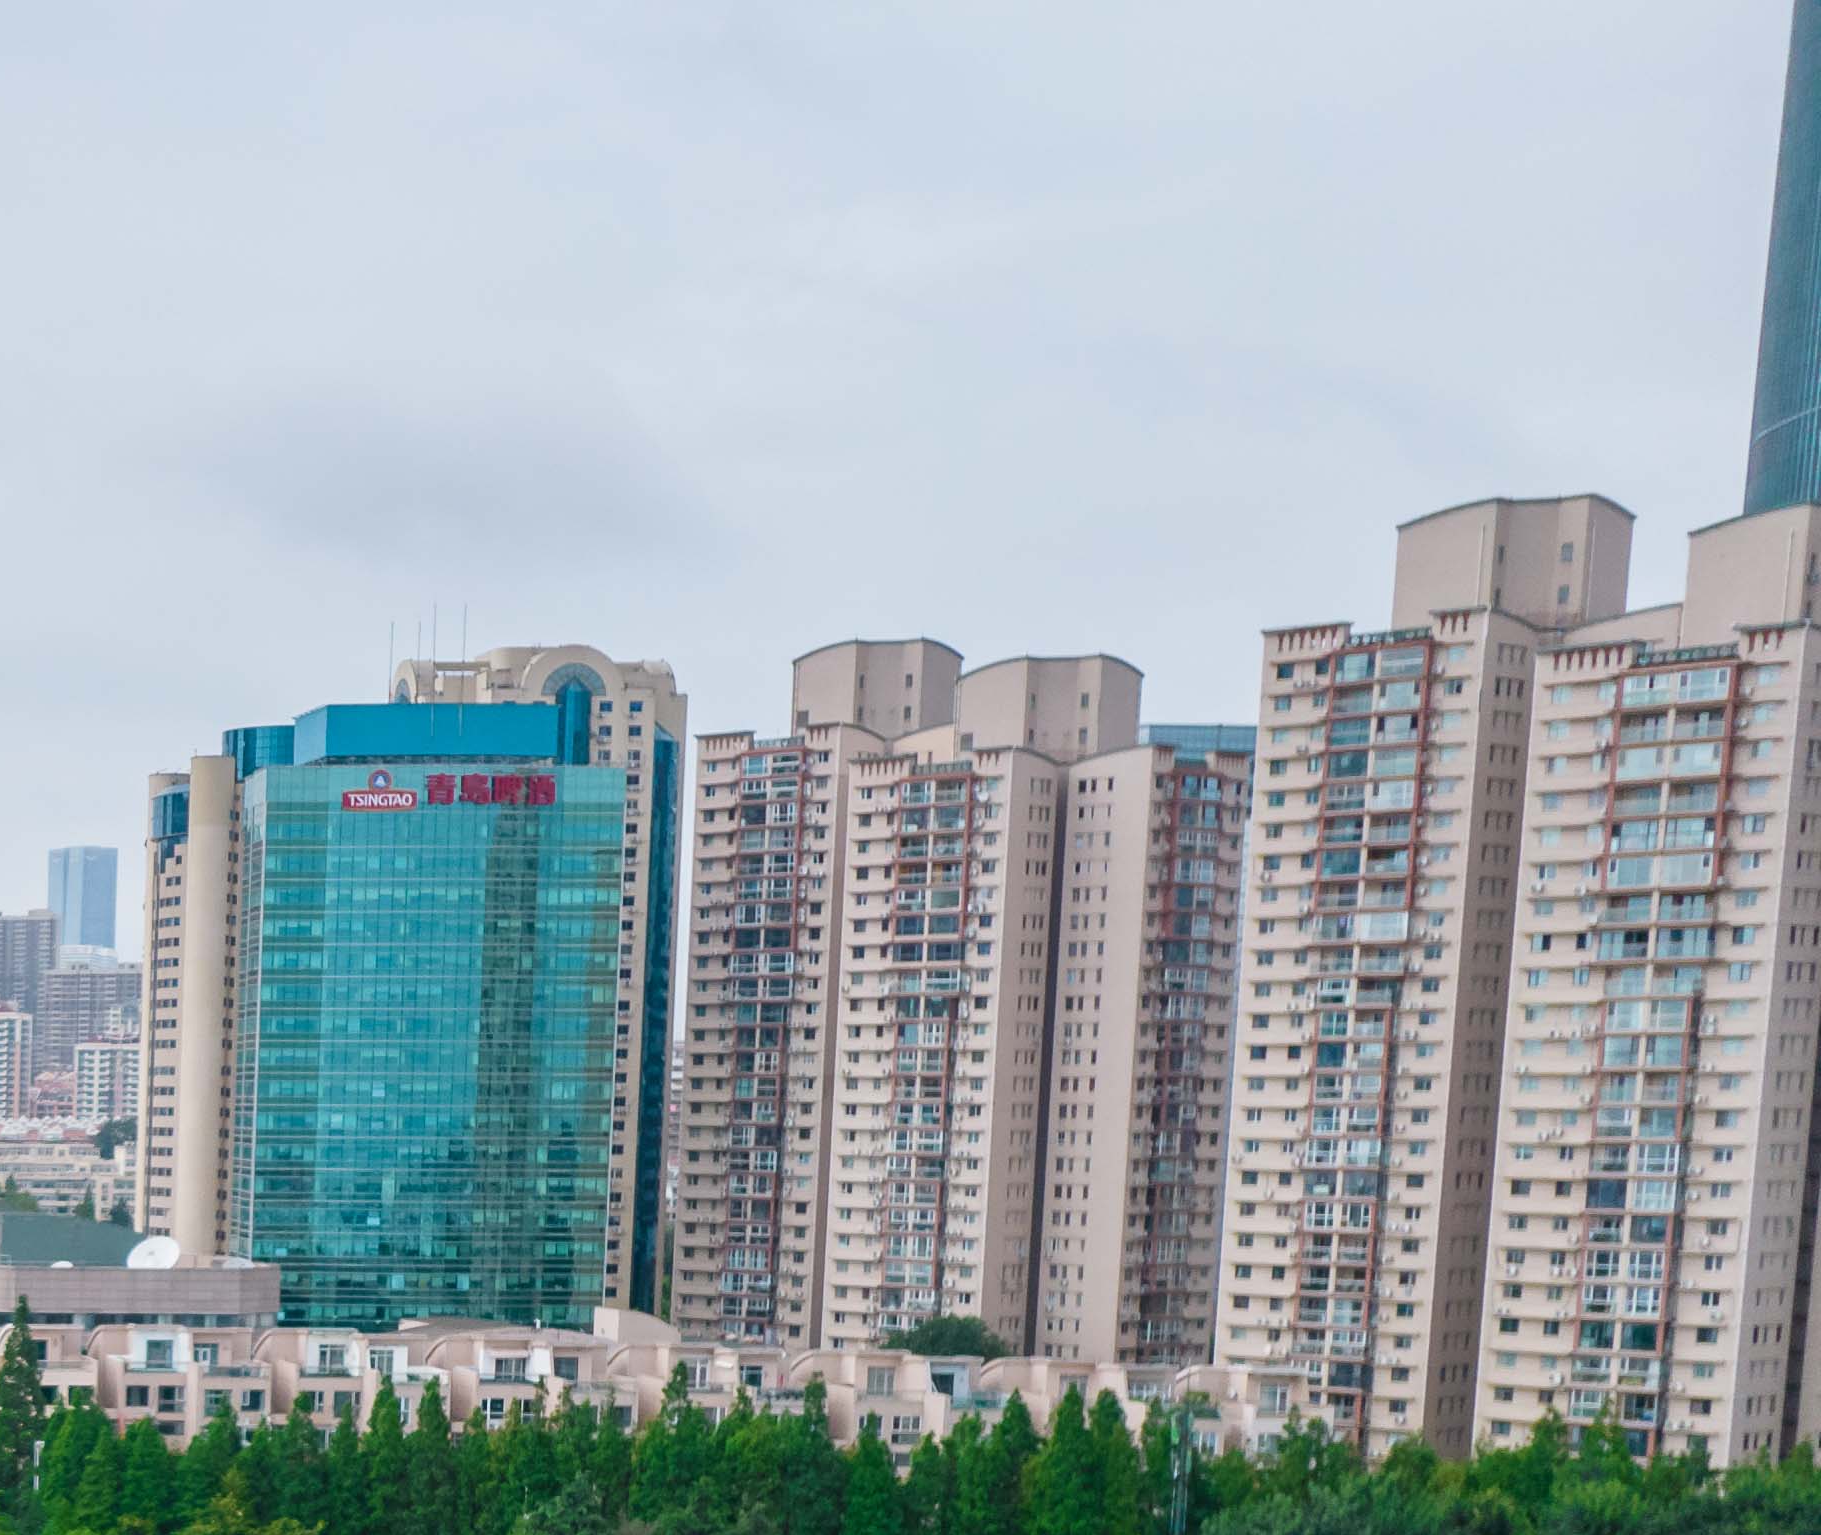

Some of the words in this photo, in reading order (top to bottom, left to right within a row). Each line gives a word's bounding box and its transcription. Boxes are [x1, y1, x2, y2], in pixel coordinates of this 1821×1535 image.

[348, 793, 413, 807] TSINGTAO
[426, 773, 556, 806] 青岛啤酒
